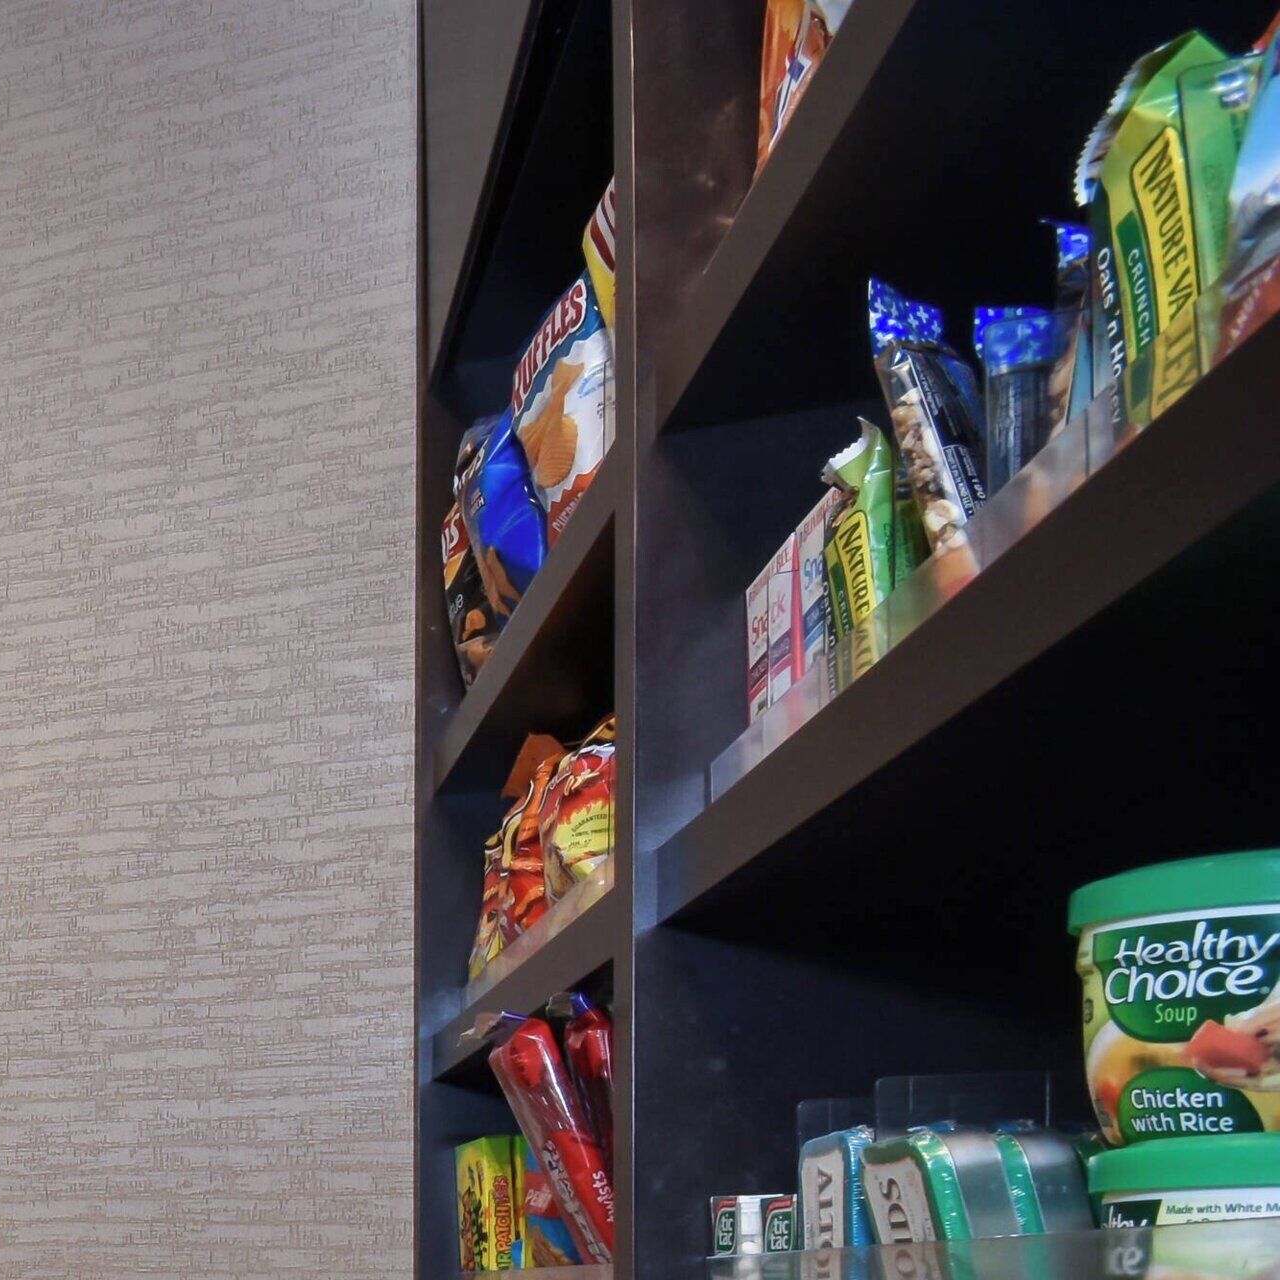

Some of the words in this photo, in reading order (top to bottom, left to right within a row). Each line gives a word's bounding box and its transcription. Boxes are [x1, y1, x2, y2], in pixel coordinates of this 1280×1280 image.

[1140, 140, 1185, 280] NATURE
[1096, 247, 1115, 310] Oats
[1126, 248, 1153, 347] CRUNCH
[839, 521, 871, 620] NATURE
[1113, 921, 1280, 967] Healthy
[1104, 959, 1265, 1005] Choice
[1154, 1002, 1198, 1026] Soup
[1130, 1087, 1223, 1109] Chicken
[1130, 1113, 1176, 1132] with
[1179, 1112, 1234, 1132] Rice
[1165, 1204, 1194, 1214] Made
[1196, 1203, 1222, 1214] with
[1224, 1202, 1263, 1214] White
[720, 1214, 734, 1231] tic
[771, 1215, 790, 1233] tic
[719, 1232, 734, 1246] tac
[770, 1234, 790, 1251] tac
